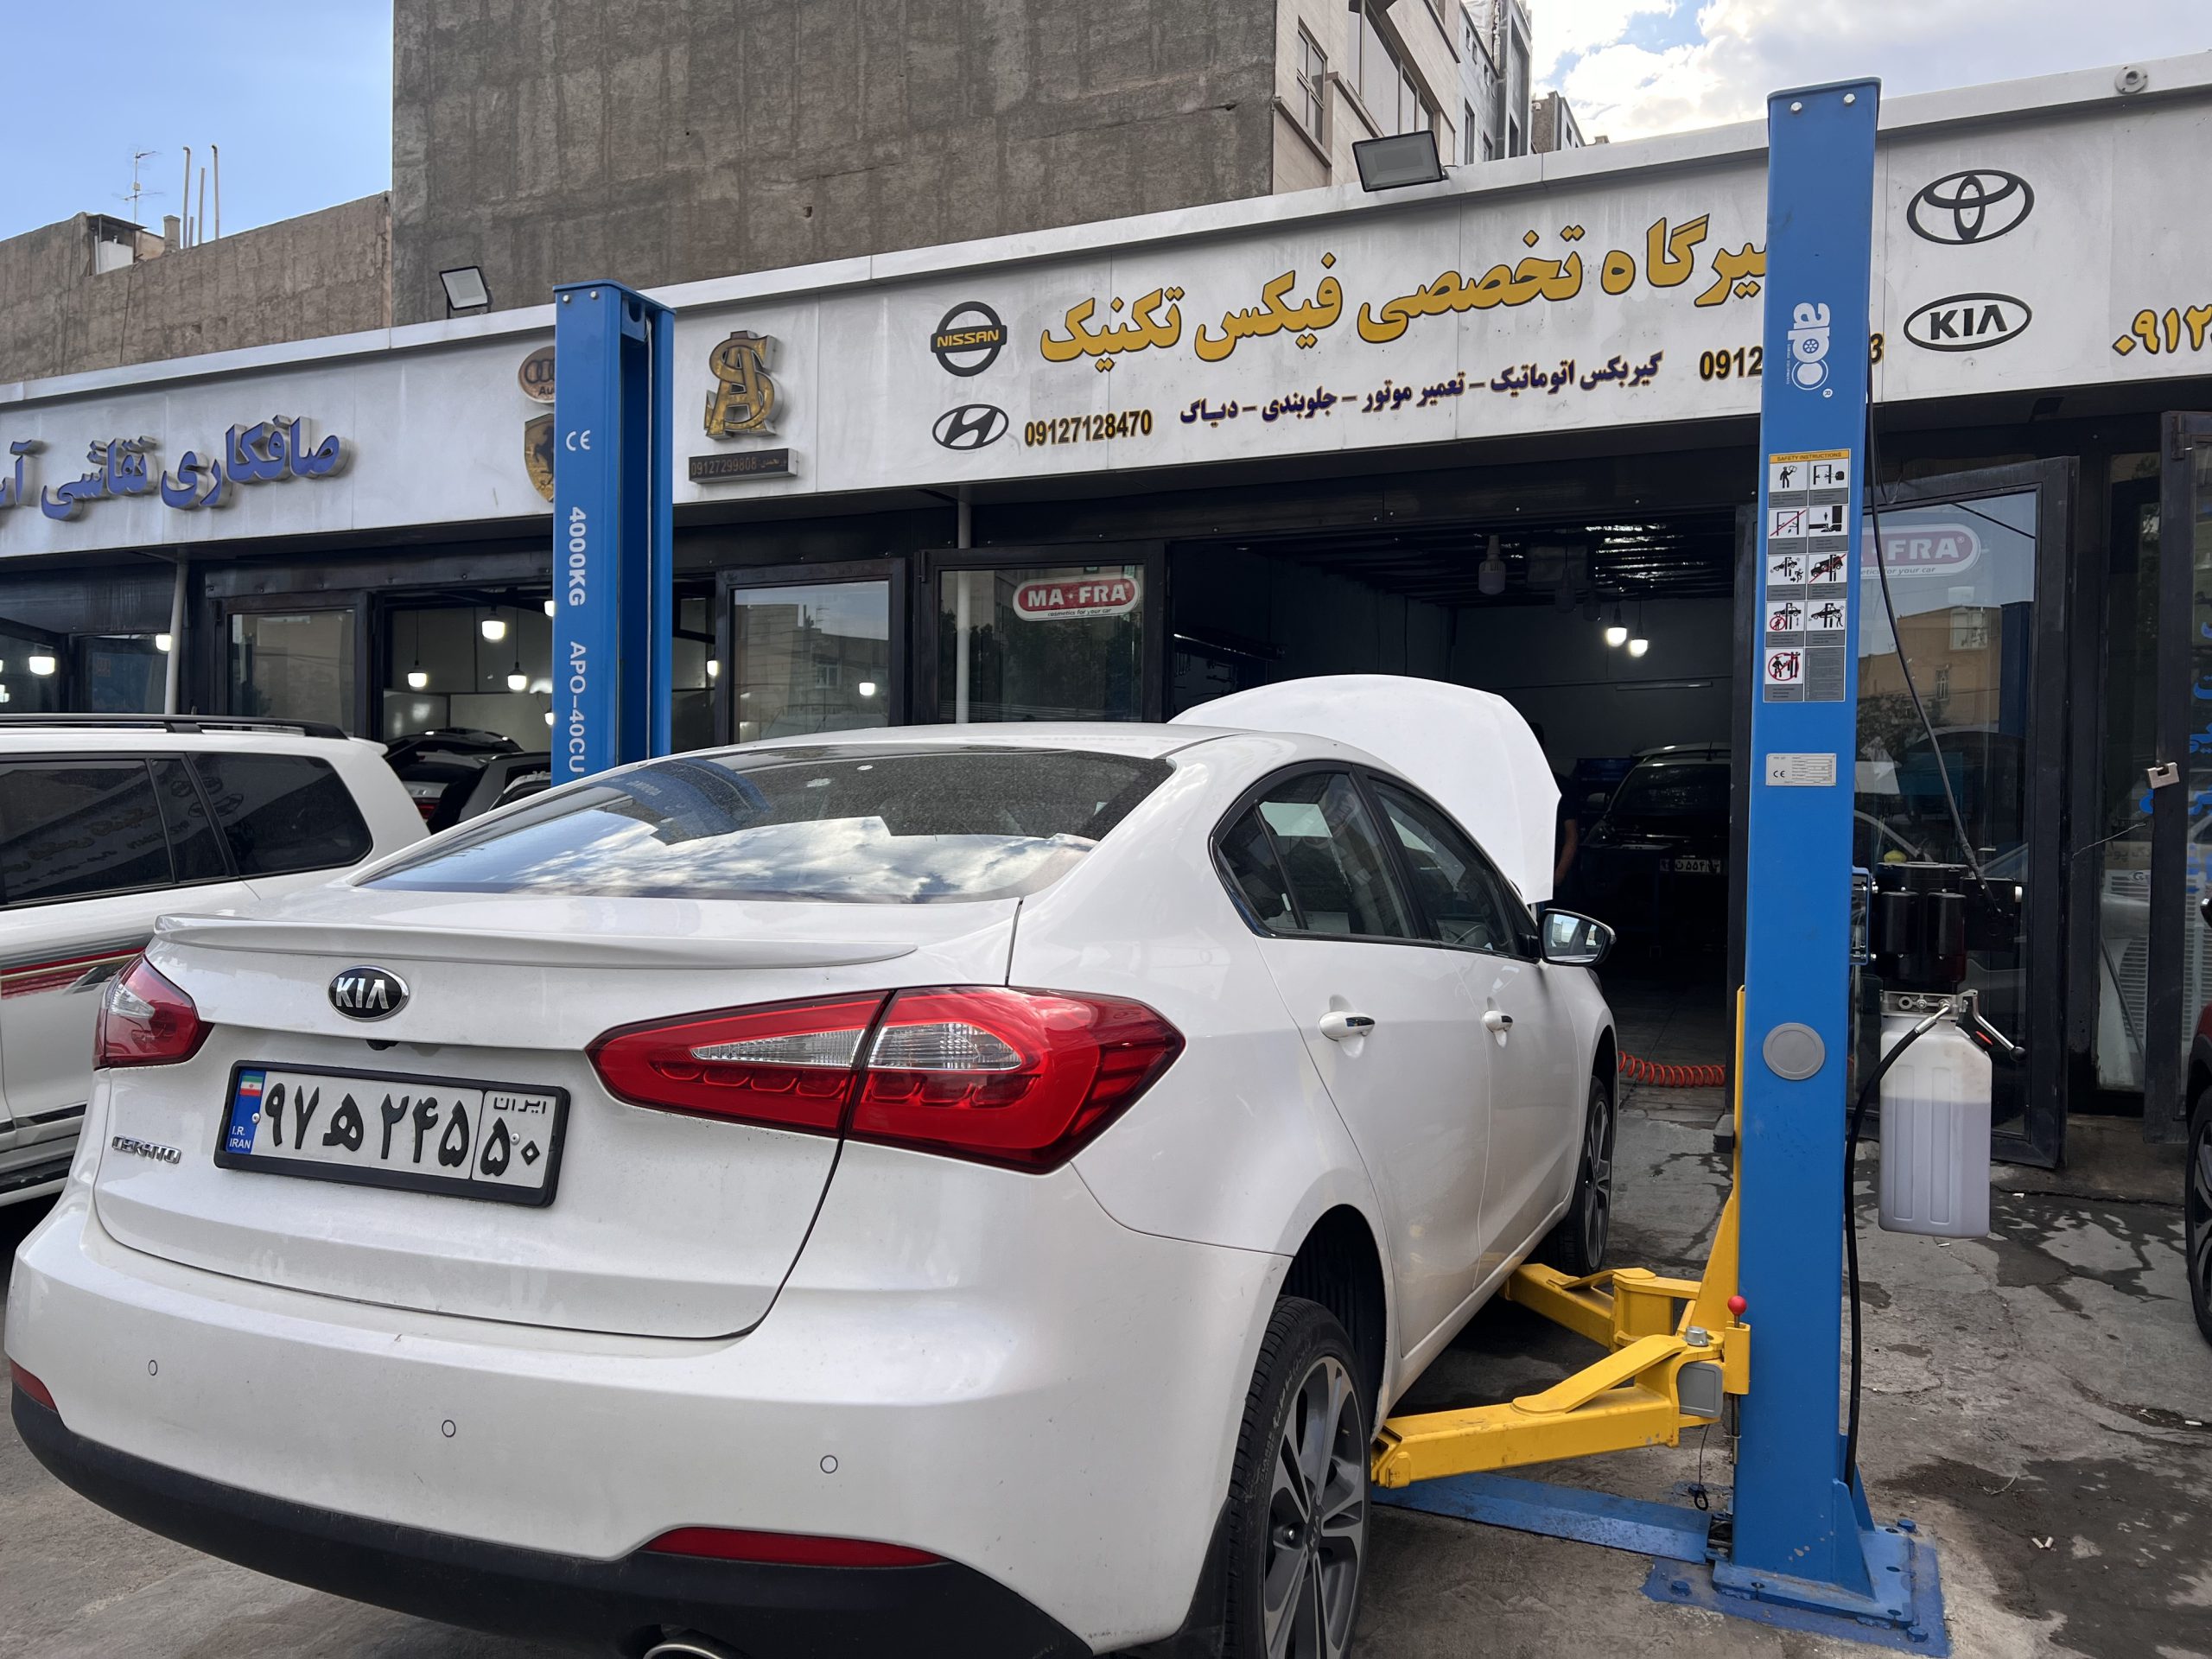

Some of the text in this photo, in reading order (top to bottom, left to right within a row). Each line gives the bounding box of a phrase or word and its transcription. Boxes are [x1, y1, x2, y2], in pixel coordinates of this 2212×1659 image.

[1040, 213, 1767, 372] یرگاه تخصصی فیکس تکنیک
[937, 328, 999, 347] NISSAN
[1929, 304, 2008, 340] KIA
[2113, 304, 2212, 356] ۰۹۱۲
[1180, 349, 1664, 429] گیربکس اتوماتیک تعمیر موتور جلوبندی دیاگ
[1025, 410, 1152, 447] 09127128470
[41, 435, 156, 519] نقاشی
[161, 416, 342, 508] صافکاری
[691, 457, 758, 475] 09127299808
[1898, 567, 1920, 575] your
[569, 506, 587, 772] 4000KG APO-40CU
[335, 977, 390, 1009] KIA
[493, 1096, 547, 1115] ایران
[229, 1138, 251, 1150] IRAN
[232, 1126, 245, 1136] I.R.
[480, 1116, 541, 1177] ۵۰
